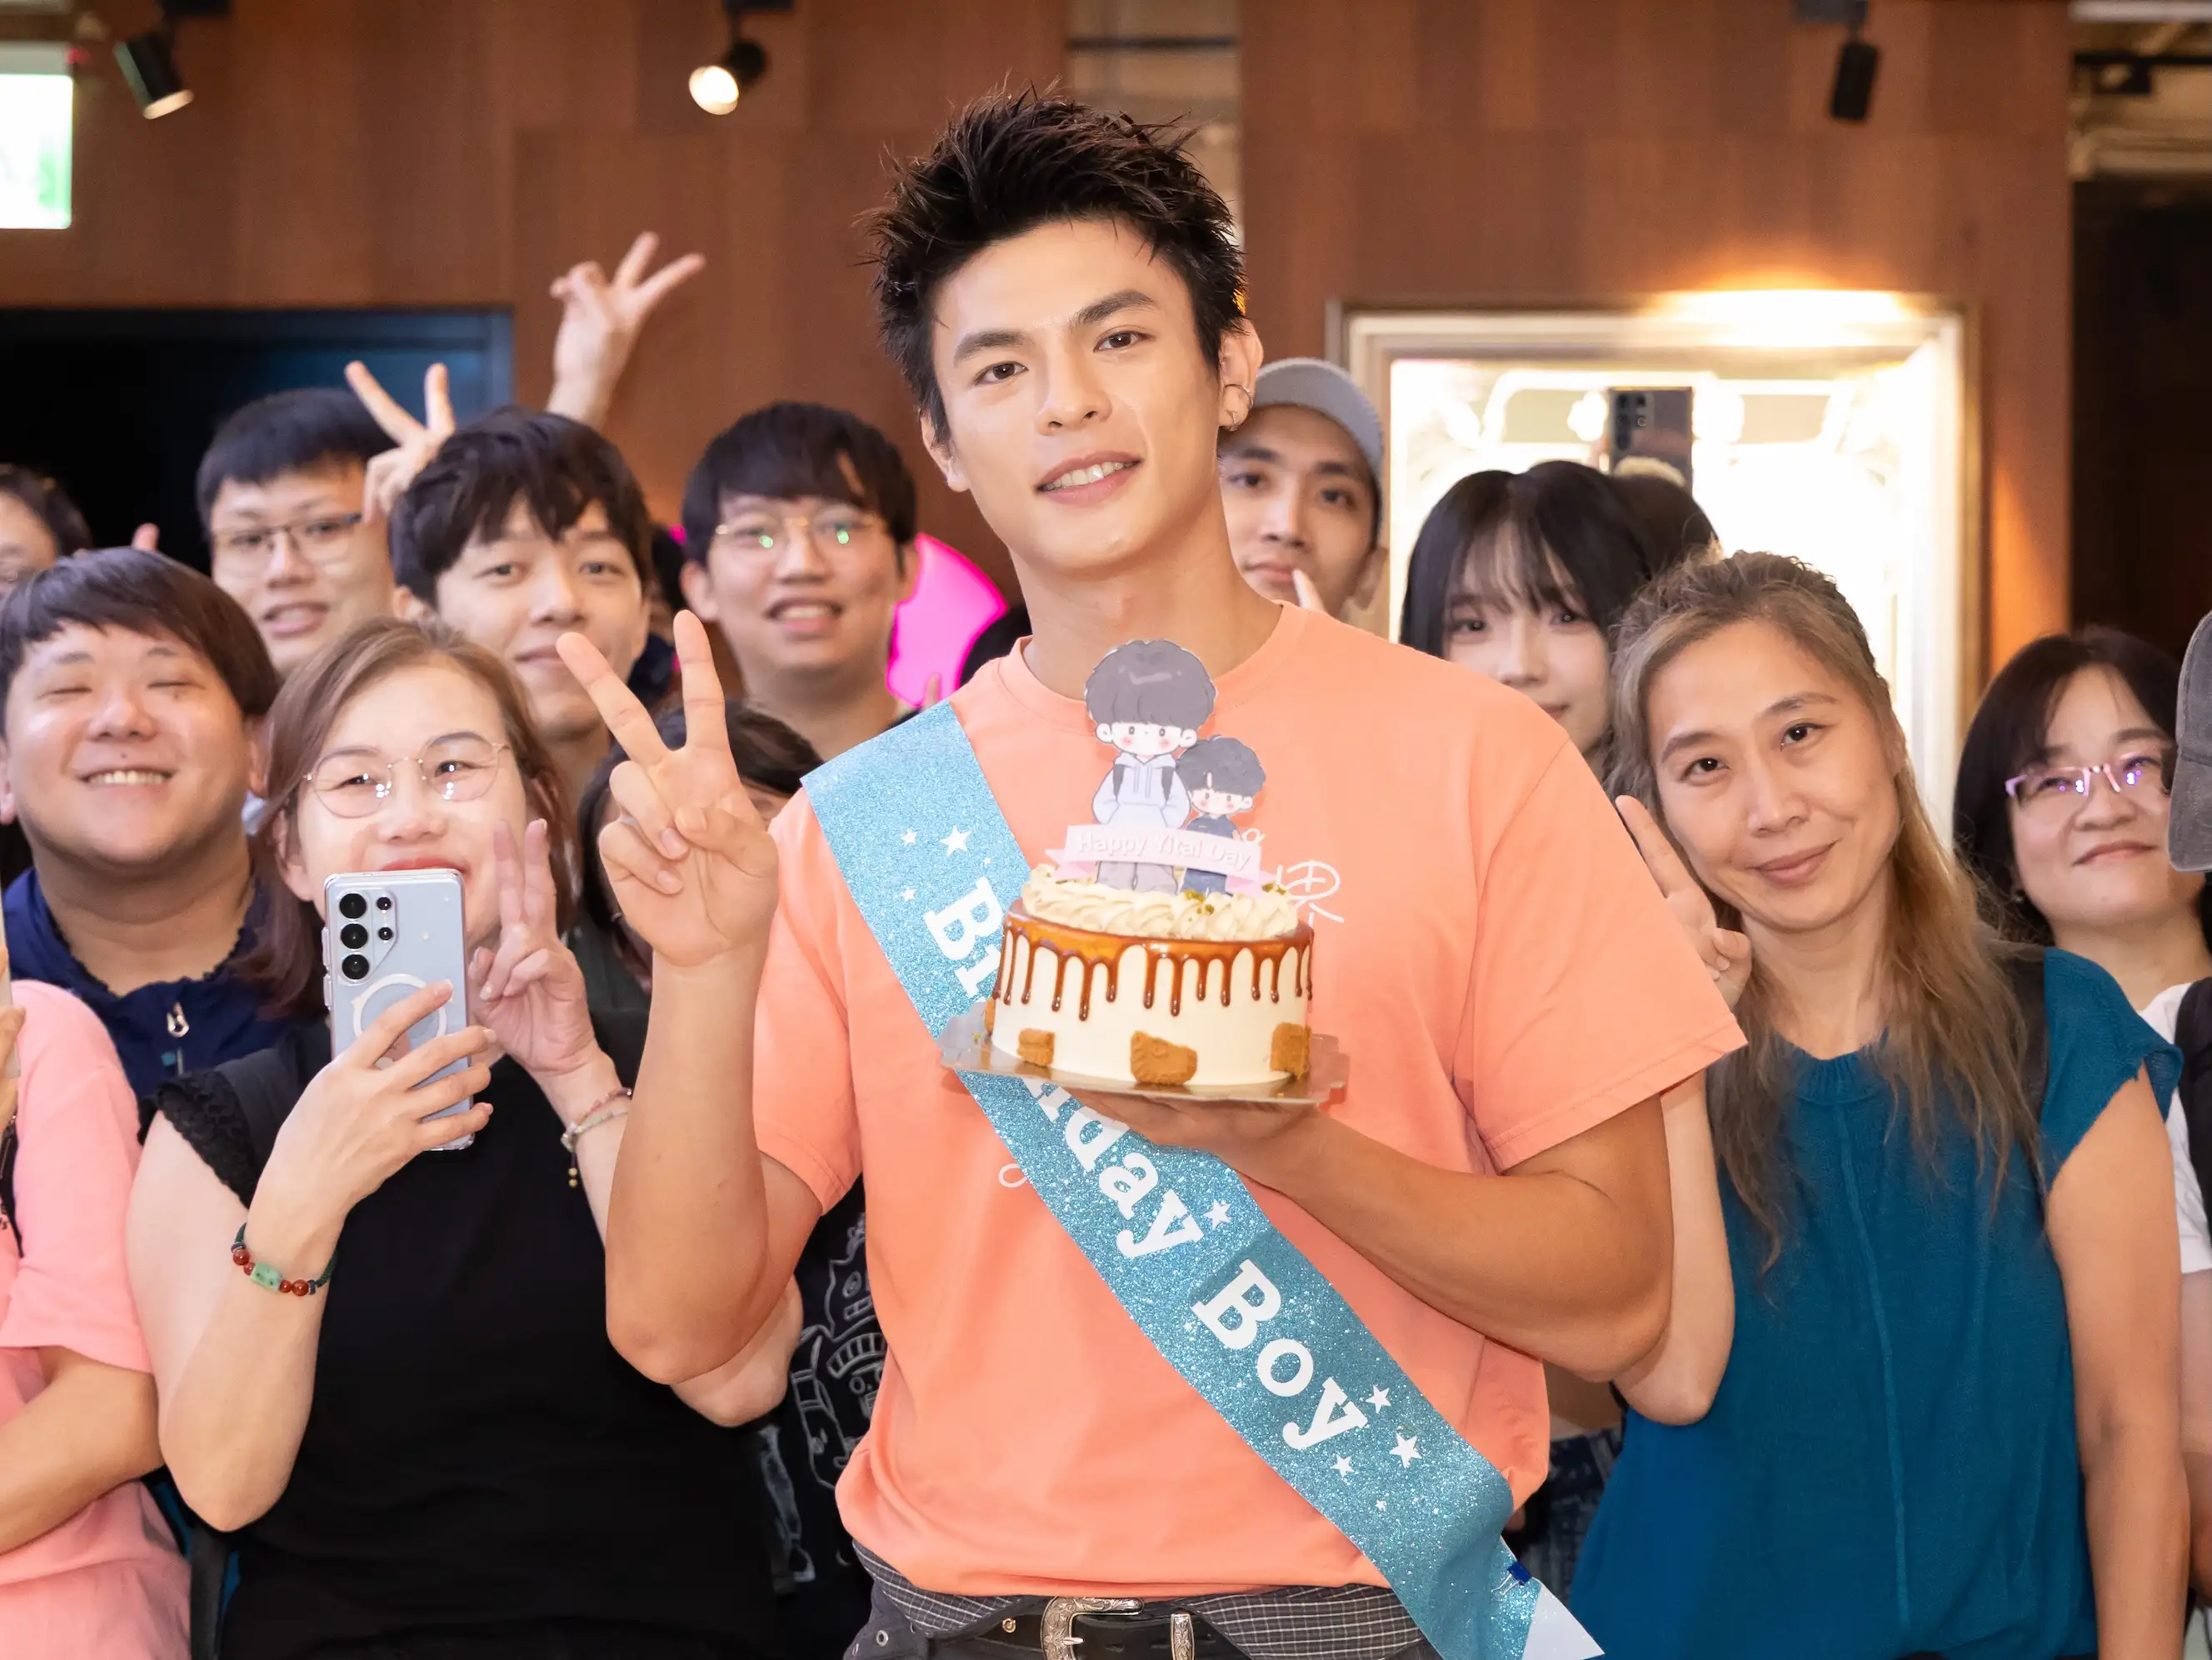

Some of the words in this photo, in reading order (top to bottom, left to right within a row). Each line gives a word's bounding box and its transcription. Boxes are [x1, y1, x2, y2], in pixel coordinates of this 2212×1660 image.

[1078, 832, 1150, 858] Happy
[1207, 843, 1254, 872] Day
[923, 876, 1205, 1260] Biday
[1191, 1258, 1368, 1450] Boy
